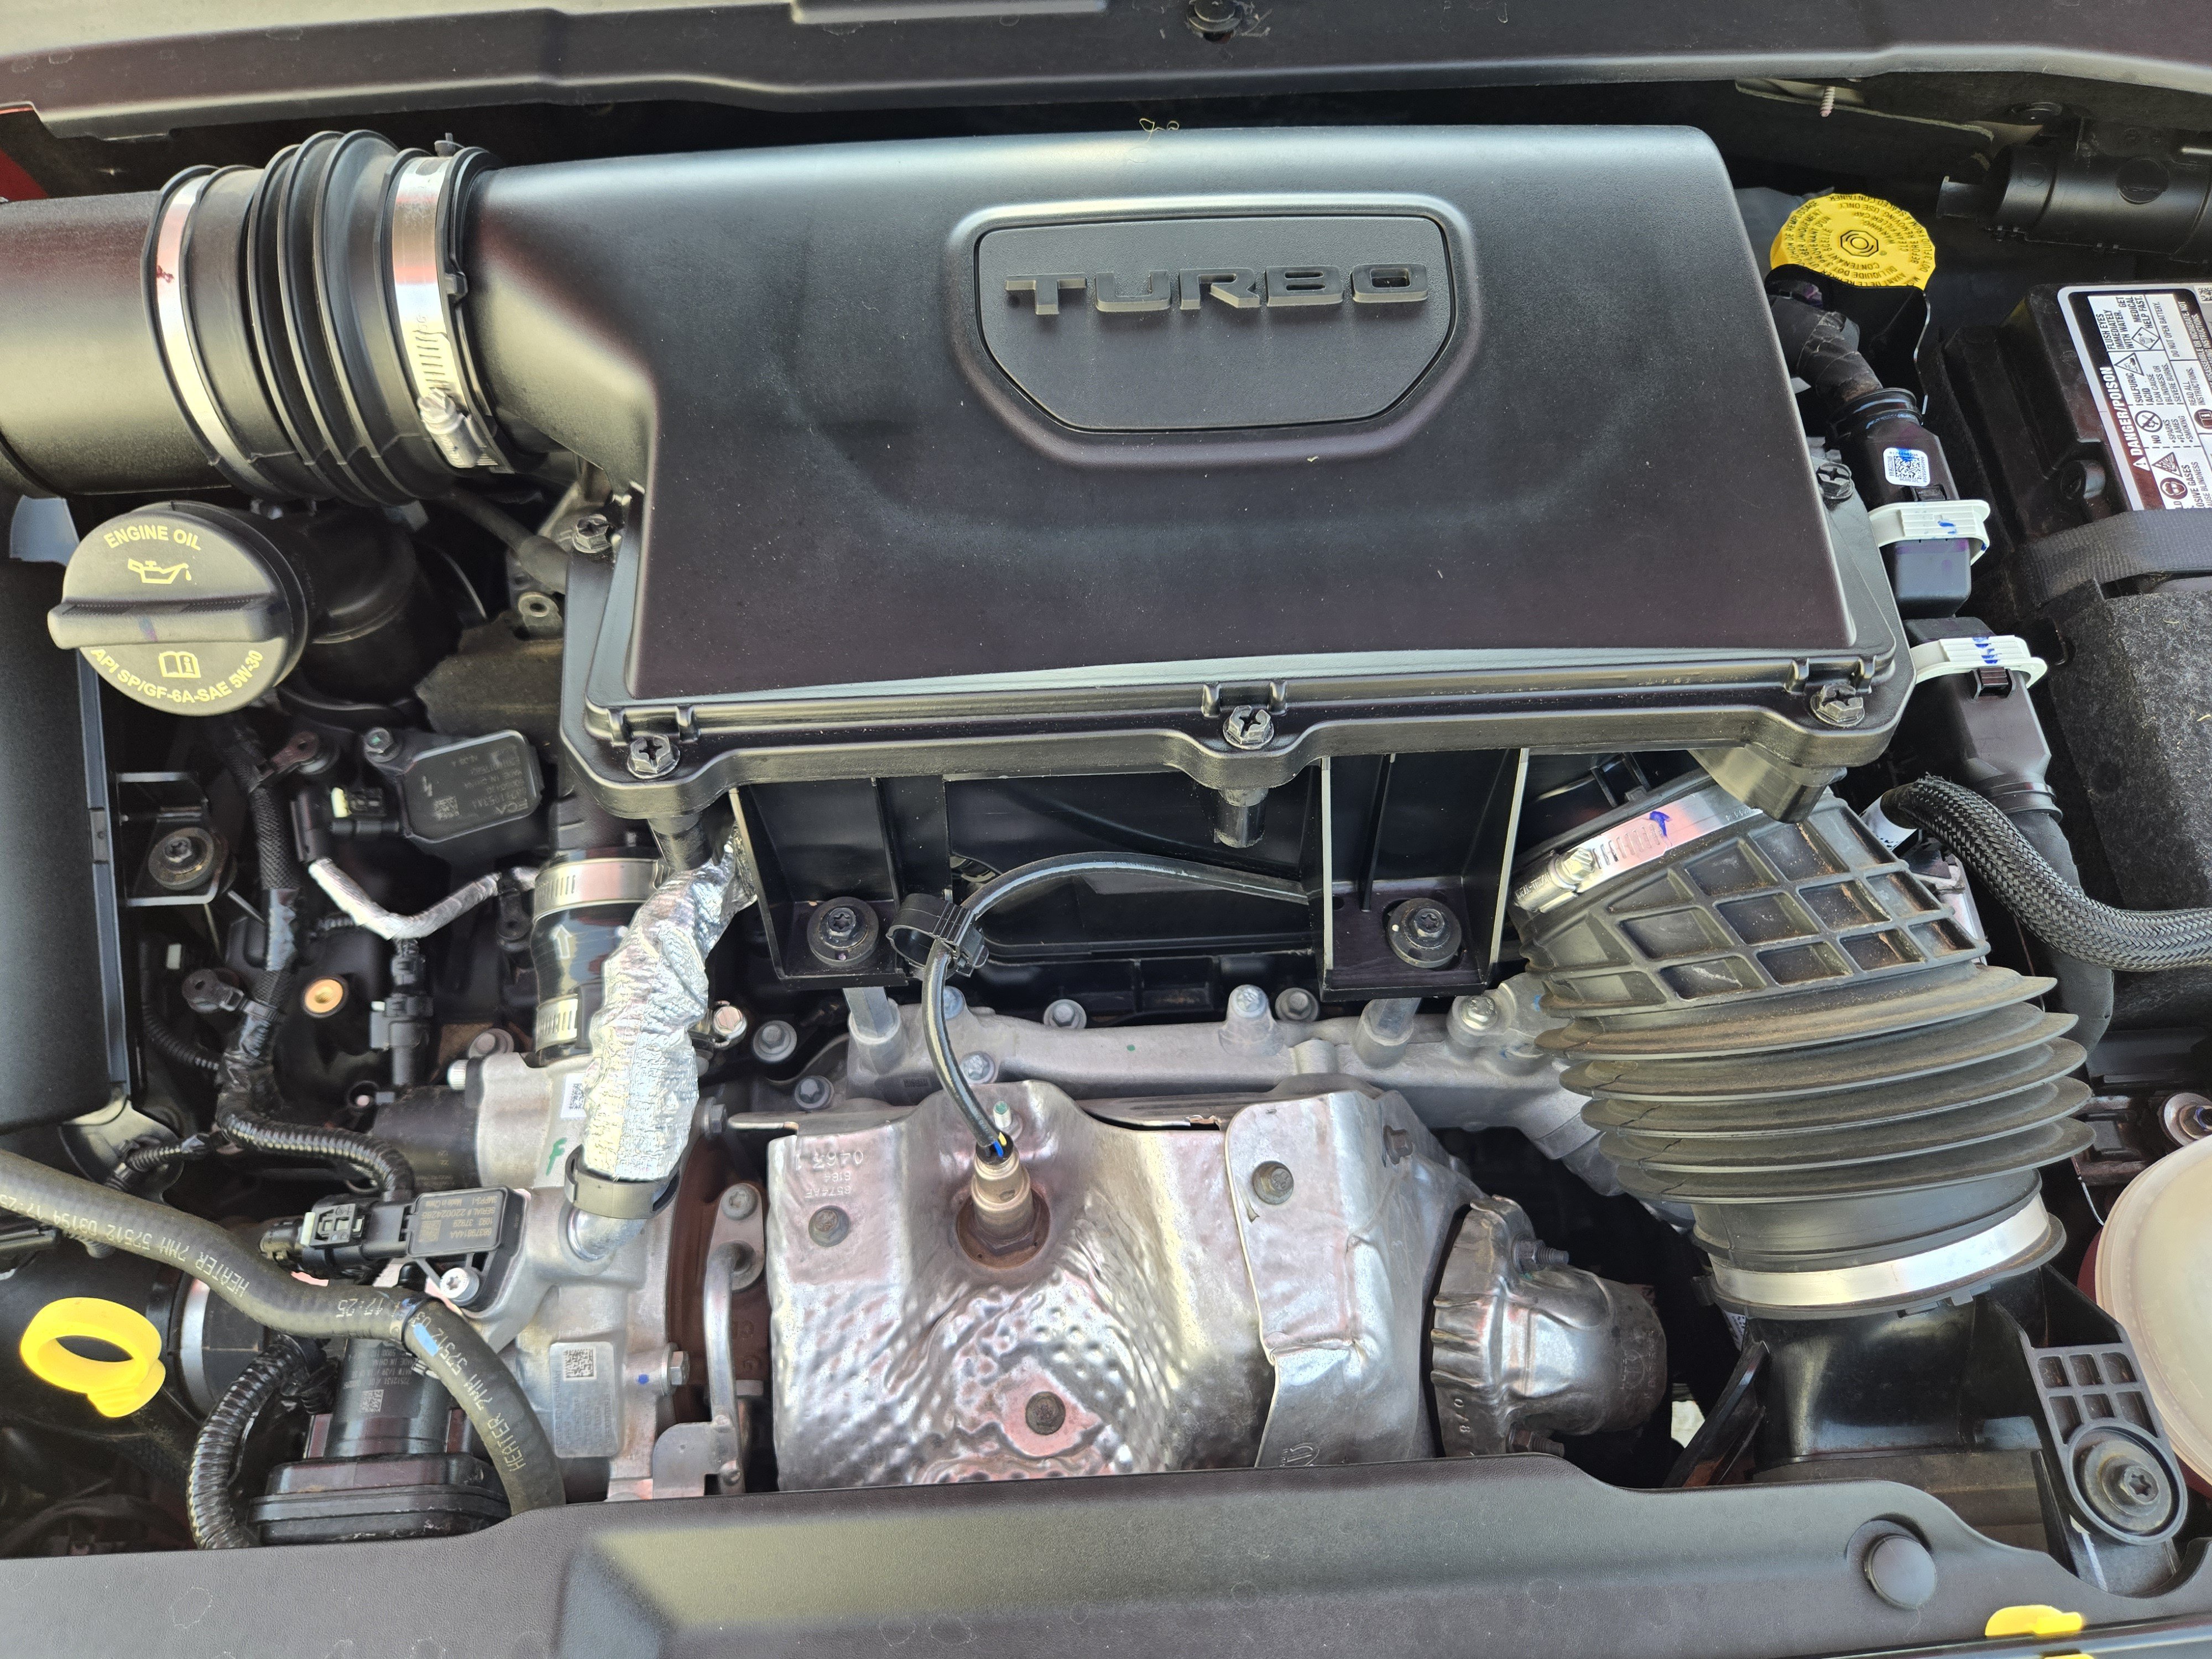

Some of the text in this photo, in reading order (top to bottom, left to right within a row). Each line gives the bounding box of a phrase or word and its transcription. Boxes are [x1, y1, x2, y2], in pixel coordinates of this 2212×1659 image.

[1786, 200, 1819, 231] REMPLISSAGE
[1863, 205, 1880, 214] USE
[1797, 208, 1823, 243] UNIQUEMENT
[1872, 215, 1897, 232] FILLER
[1909, 220, 1926, 238] FROM
[1785, 232, 1794, 241] DE
[1809, 227, 1827, 264] PROVENANT
[1895, 232, 1909, 252] CLEAN
[1921, 237, 1933, 255] FLUID
[1827, 252, 1880, 270] CONTENANT
[1910, 240, 1921, 264] BEFORE
[1833, 266, 1850, 277] DOT
[1853, 270, 1887, 279] LIQUIDE
[1882, 272, 1907, 286] AVANT
[1885, 266, 1898, 276] DU
[1919, 261, 1931, 273] DOT
[1004, 262, 1430, 316] TURBO
[2116, 296, 2127, 308] GET
[2125, 296, 2143, 323] MEDICAL
[2134, 296, 2154, 329] HELP FAST.
[2152, 301, 2168, 325] BATTERY.
[2177, 301, 2188, 312] NOT
[2095, 314, 2116, 350] FLUSH EYES
[2103, 309, 2125, 349] IMMEDIATELY
[2114, 310, 2135, 349] WITH WATER.
[2161, 325, 2173, 338] OPEN
[2166, 338, 2177, 350] NOT
[2125, 373, 2144, 403] SULFURIC
[2146, 373, 2163, 402] CAN CAUSE
[2156, 373, 2173, 402] BLINDNESS
[2161, 363, 2182, 402] SEVERE BURNS.
[2182, 380, 2198, 406] READ ALL
[2185, 367, 2206, 406] INSTRUCTIONS.
[2141, 388, 2154, 403] ACID
[2099, 367, 2144, 456] DANGER/POISON
[2151, 435, 2162, 444] NO
[2181, 464, 2197, 486] GASES
[2190, 461, 2209, 492] BLINDNESS
[103, 524, 201, 551] ENGINE OIL
[91, 648, 263, 703] API SP/GF-6A-SAE 5W-30
[447, 1198, 463, 1207] Made
[473, 1207, 496, 1215] SERIAL
[53, 1213, 98, 1236] 03194
[452, 1217, 493, 1228] 1093 37929
[107, 1224, 153, 1250] 57512
[160, 1236, 190, 1262] 7MM
[194, 1251, 250, 1298] HEATER
[487, 1412, 526, 1472] HEATER
